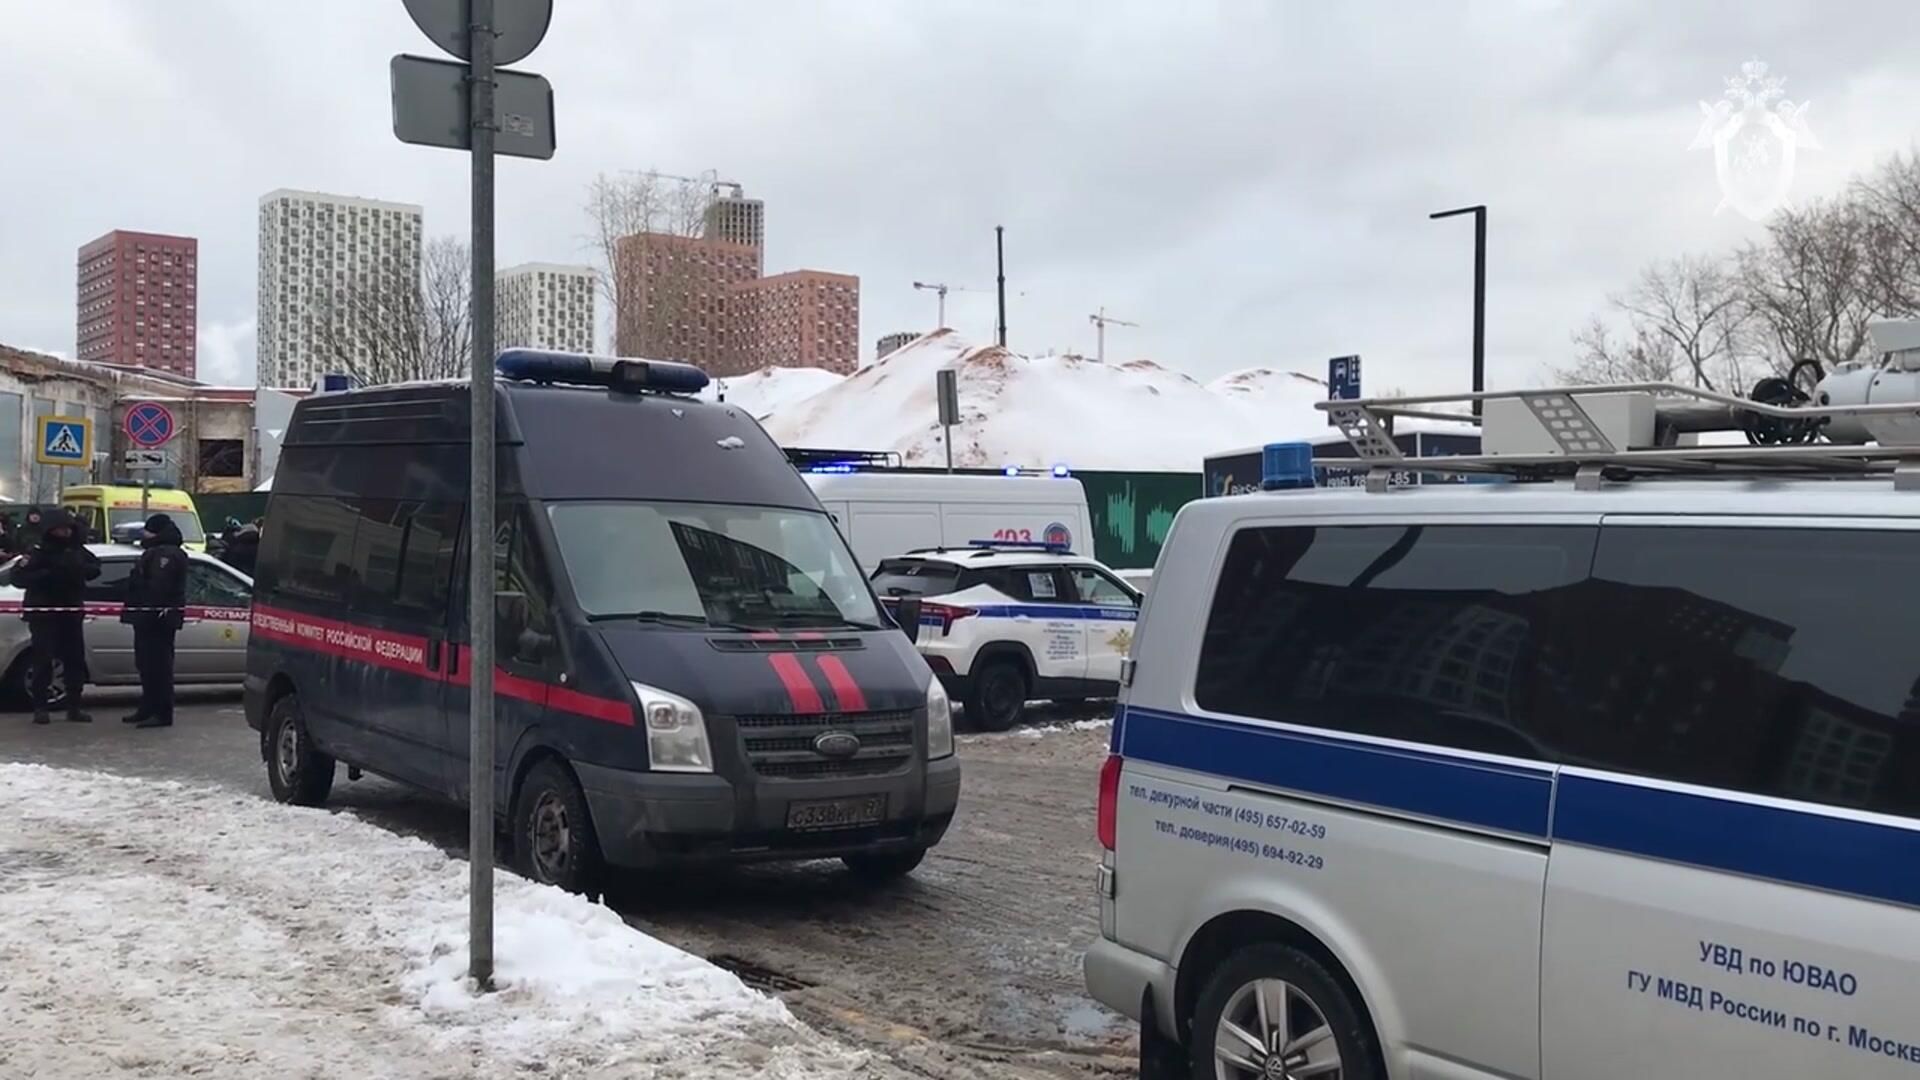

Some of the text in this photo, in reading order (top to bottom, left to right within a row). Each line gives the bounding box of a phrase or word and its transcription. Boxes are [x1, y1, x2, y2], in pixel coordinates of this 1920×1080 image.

[993, 528, 1032, 543] 103
[296, 622, 324, 640] КОМИТЕТ
[326, 628, 372, 651] РОССИЙСКОЙ
[374, 640, 423, 664] ФЕДЕРАЦИИ
[1129, 784, 1326, 839] тел. дежурной части (495) 657-02-59
[1155, 819, 1177, 835] тел.
[1262, 844, 1324, 870] 694-92-29
[1699, 940, 1857, 996] УВД по ЮВАО
[1628, 970, 1652, 993] ГУ
[1657, 978, 1703, 1010] МВД
[1710, 991, 1787, 1029] России
[1793, 1017, 1820, 1036] по
[1828, 1023, 1841, 1042] г.
